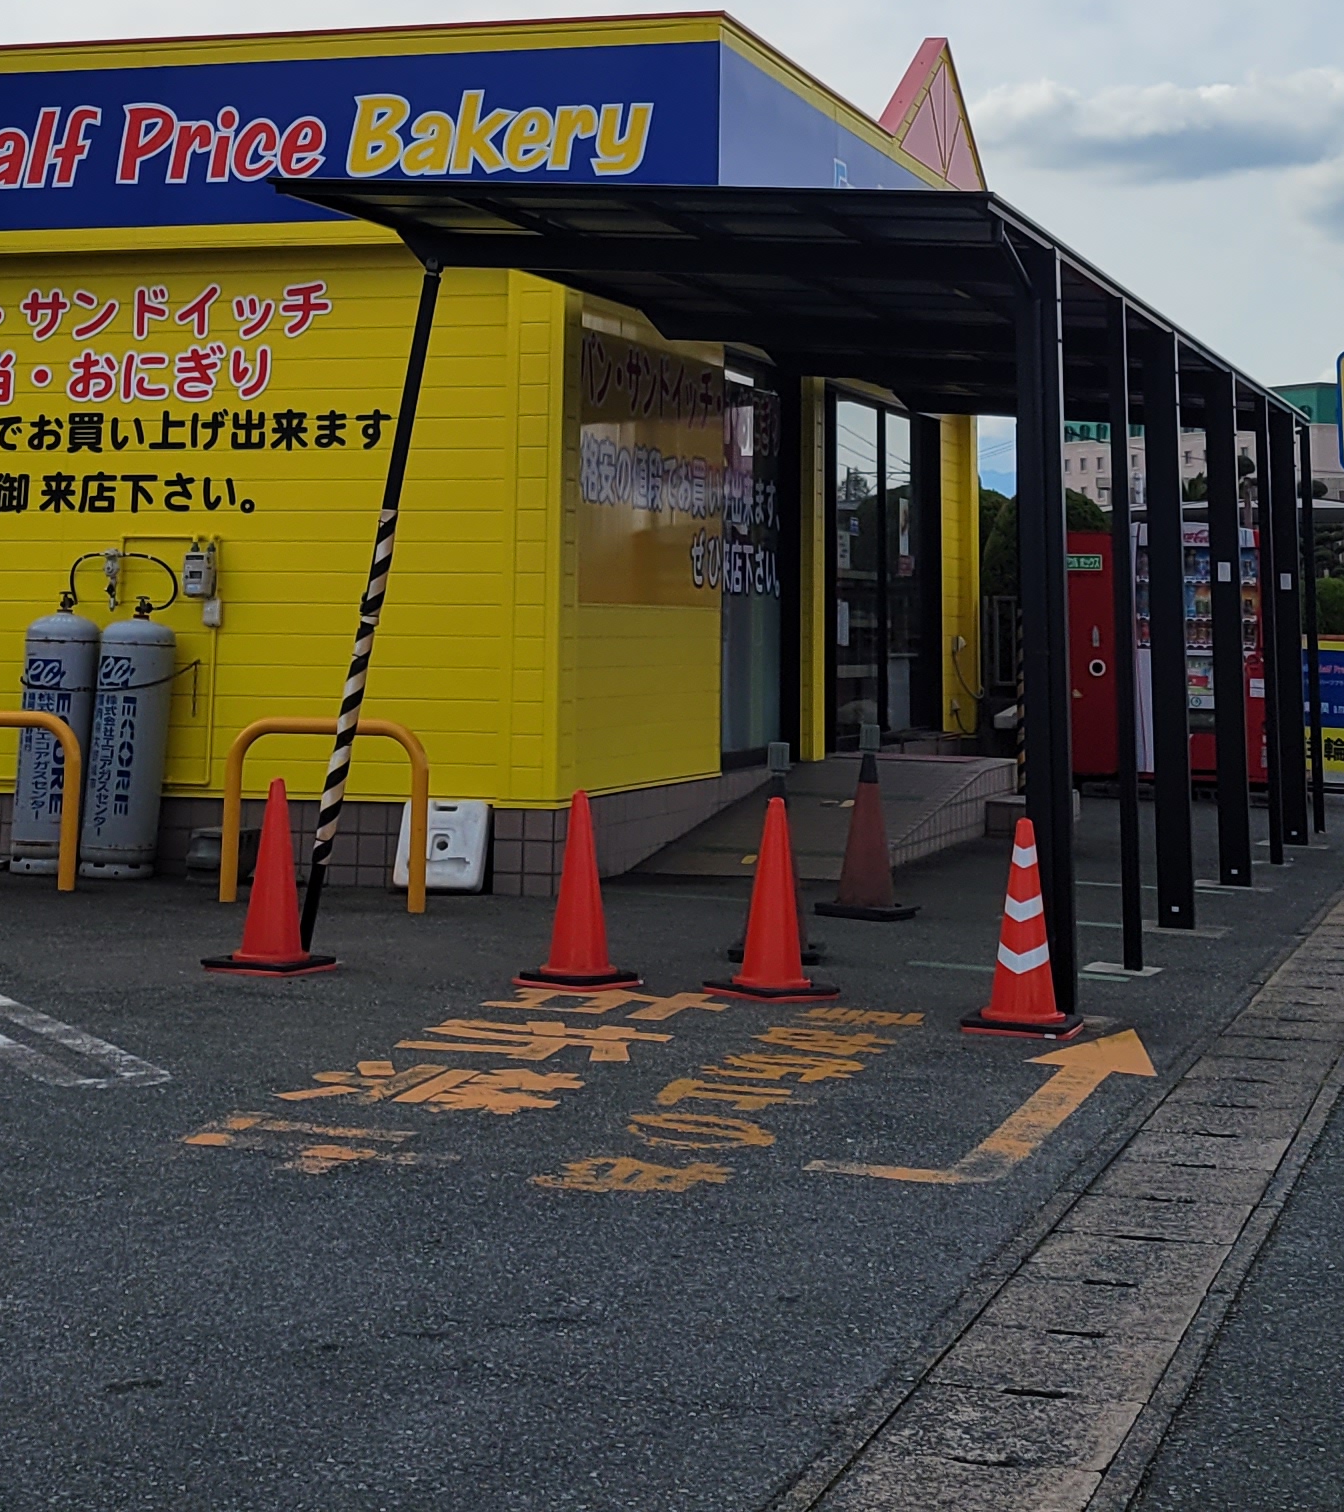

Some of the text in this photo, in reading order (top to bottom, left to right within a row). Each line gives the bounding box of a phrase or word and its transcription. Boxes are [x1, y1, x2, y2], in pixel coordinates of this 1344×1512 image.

[115, 102, 327, 185] Price
[346, 88, 655, 178] Bakery
[30, 692, 55, 820] 株式エコアガスセンター
[48, 692, 72, 816] EORE
